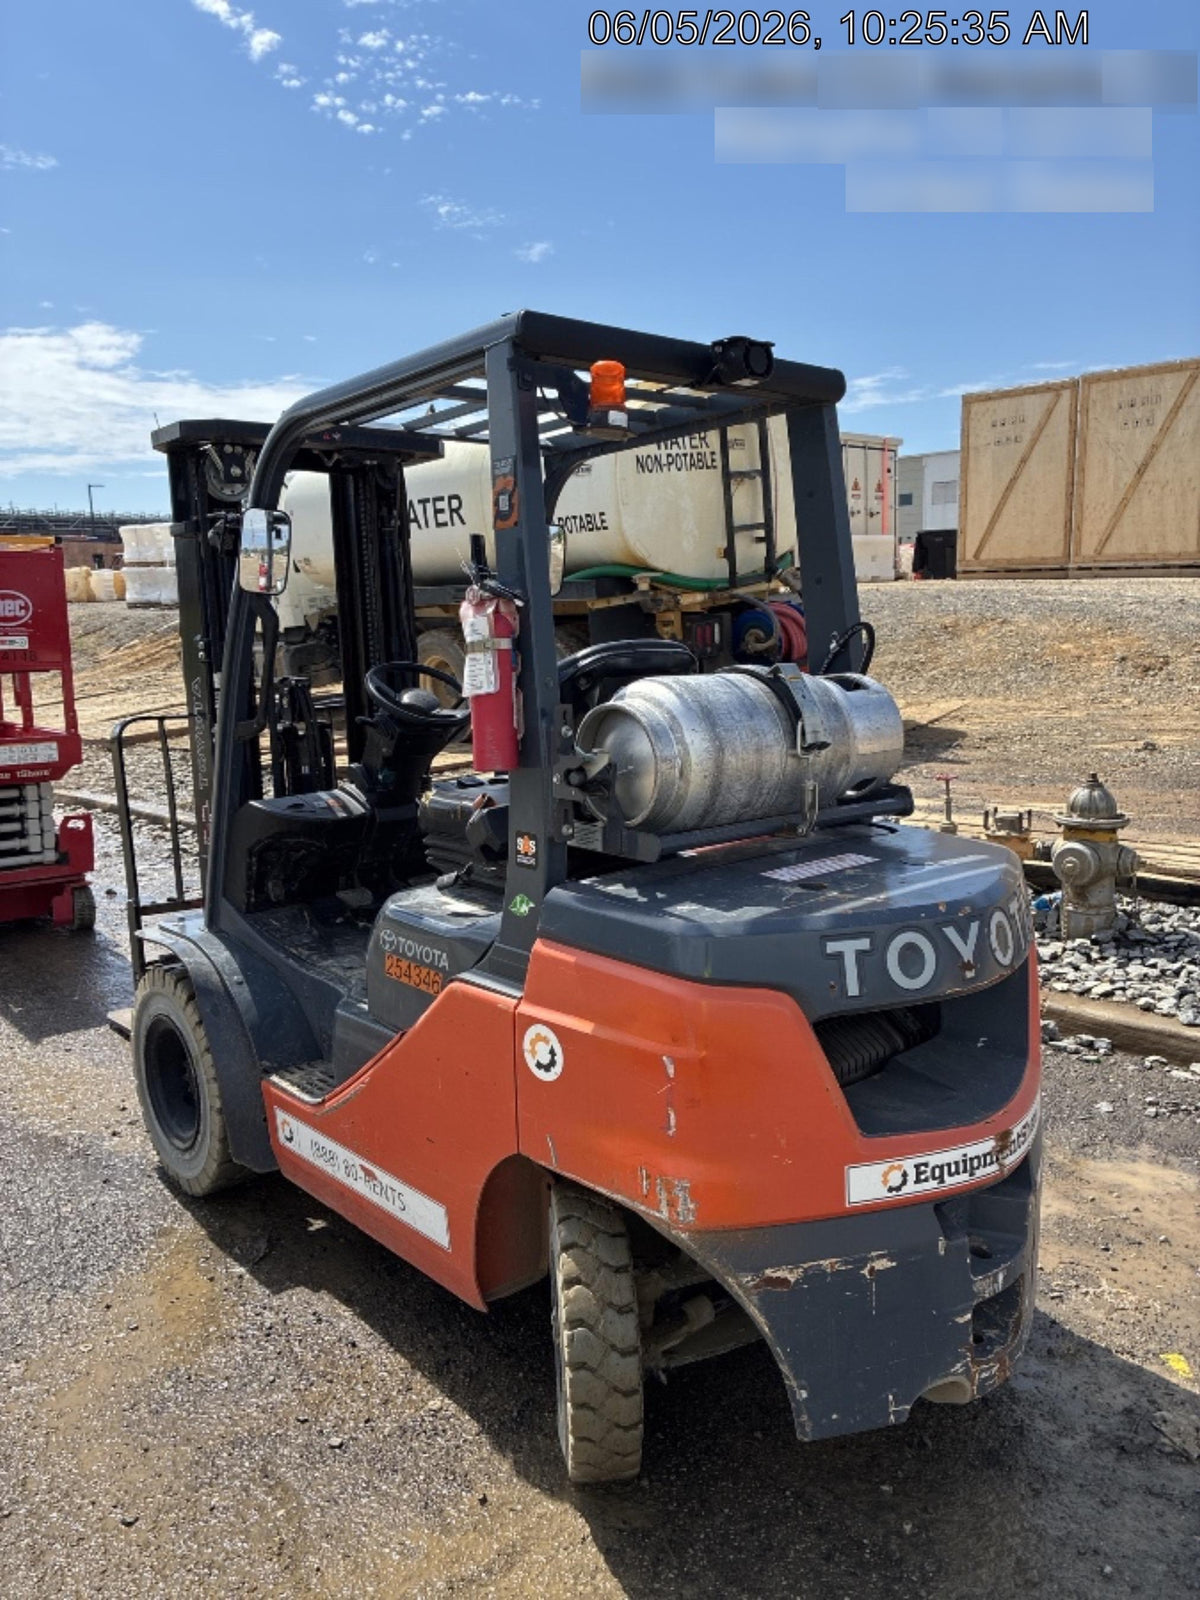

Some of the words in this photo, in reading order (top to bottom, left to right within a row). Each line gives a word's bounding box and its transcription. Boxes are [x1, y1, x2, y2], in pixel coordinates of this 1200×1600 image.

[635, 451, 718, 474] NON-POTABLE
[398, 936, 449, 971] TOYOTA
[826, 888, 1032, 997] TOYOT
[386, 954, 440, 995] 254346
